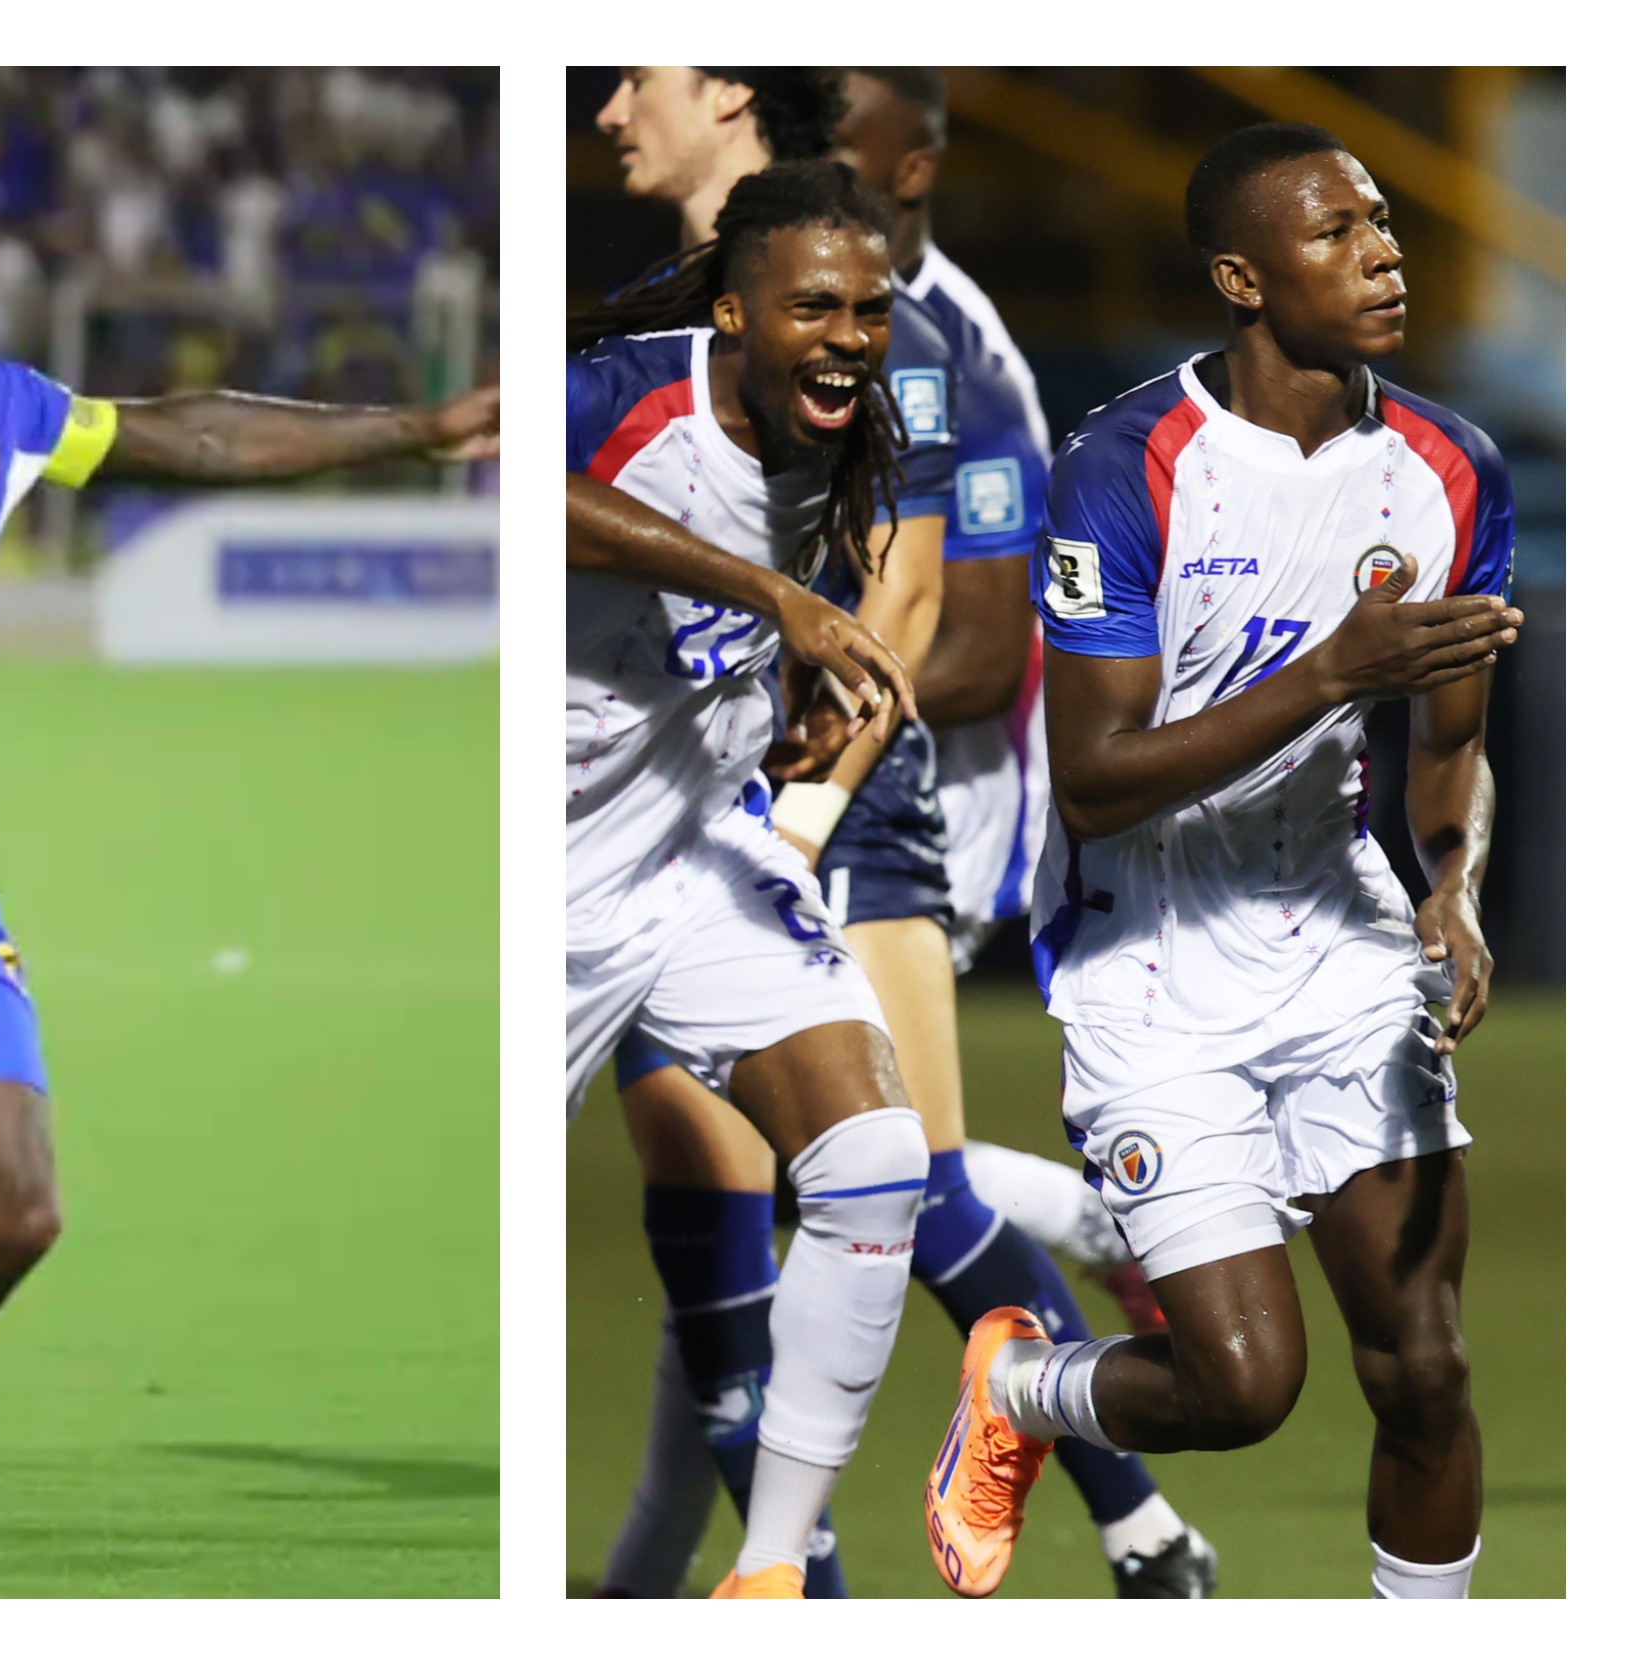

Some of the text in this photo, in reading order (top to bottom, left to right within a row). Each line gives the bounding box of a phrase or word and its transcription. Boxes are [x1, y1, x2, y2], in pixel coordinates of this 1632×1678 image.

[1180, 558, 1259, 578] SAETA
[664, 600, 764, 680] 22
[1212, 615, 1312, 699] 17
